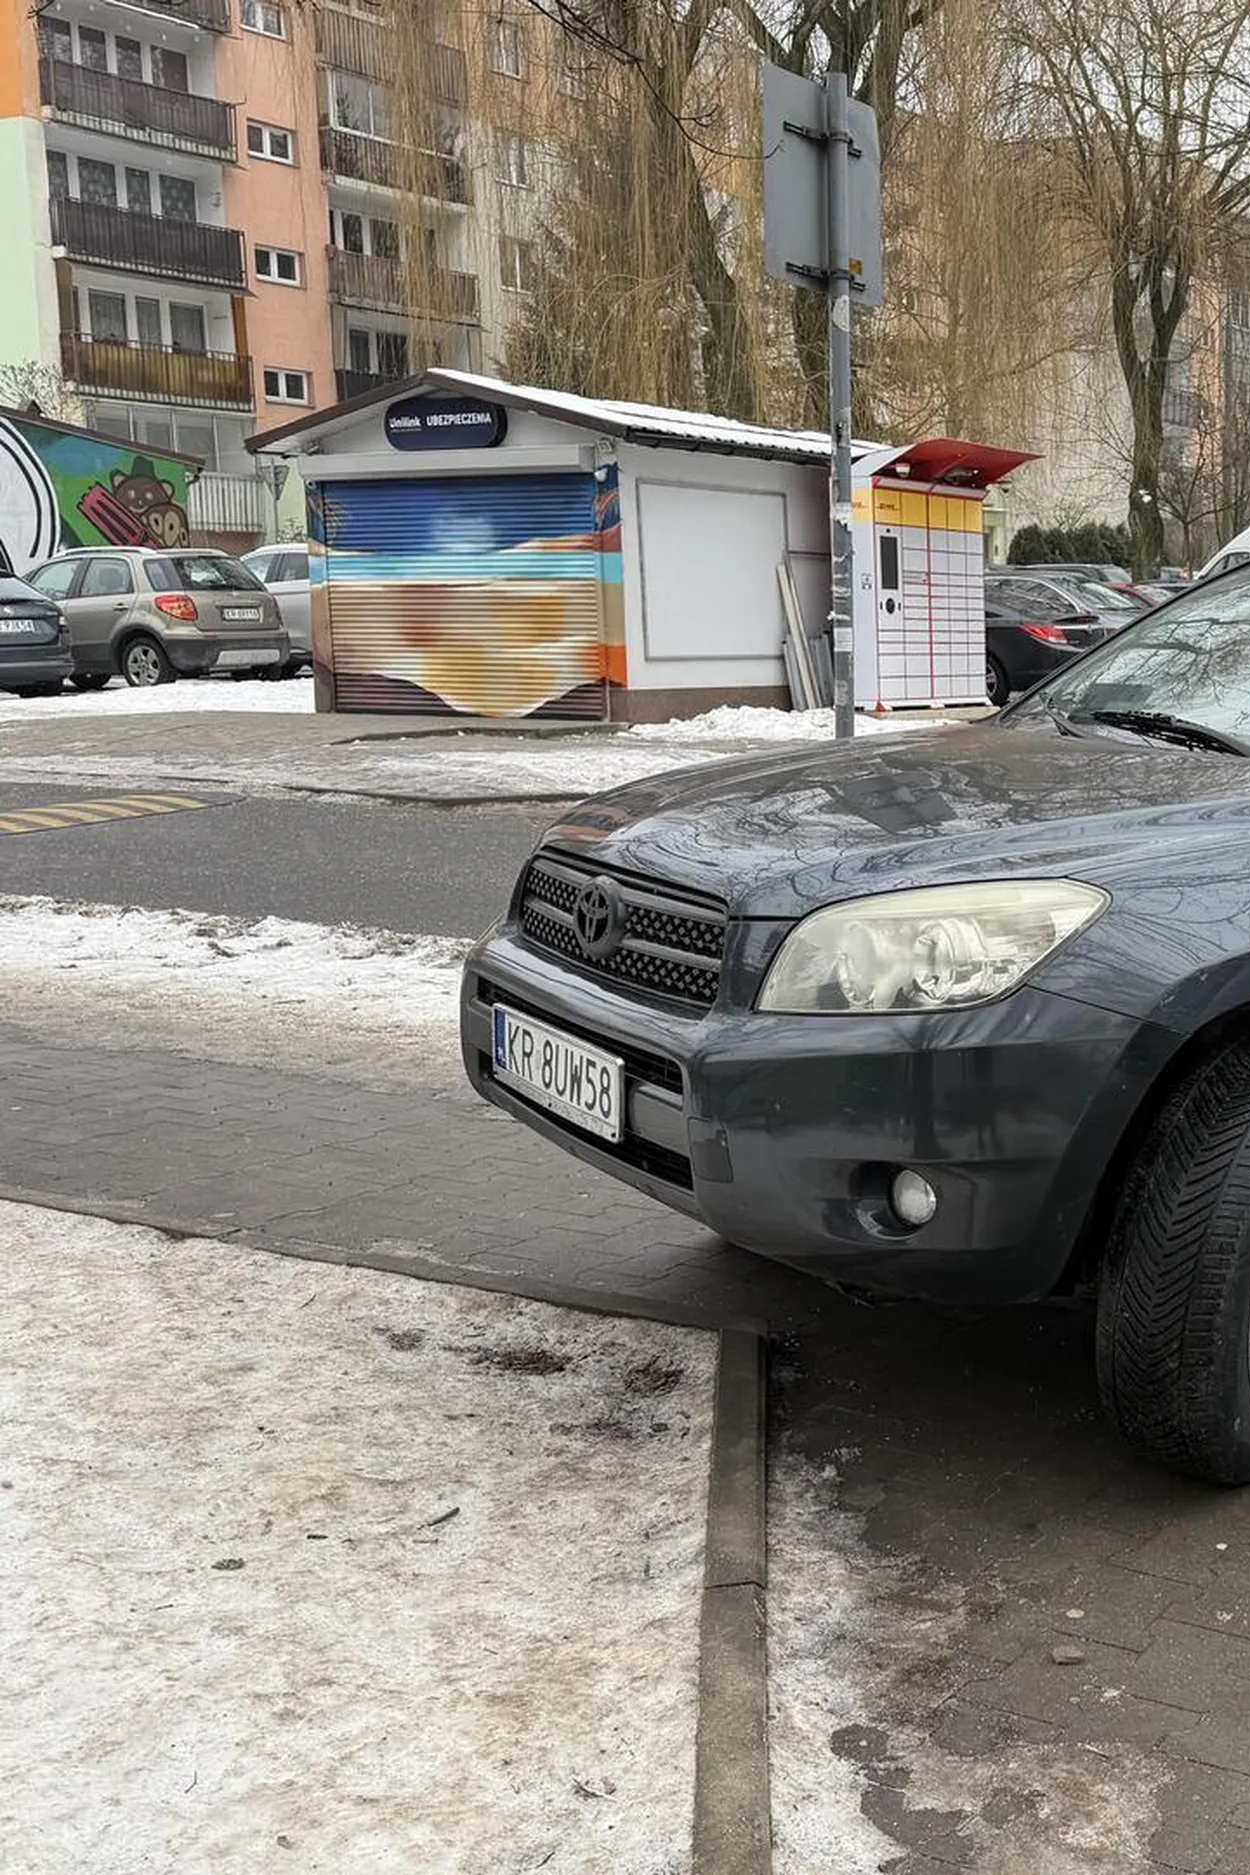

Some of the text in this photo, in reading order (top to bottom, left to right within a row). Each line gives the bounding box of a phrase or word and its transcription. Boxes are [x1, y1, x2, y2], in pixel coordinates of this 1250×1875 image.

[426, 412, 492, 426] UBEZPIECZENIA
[508, 1022, 612, 1119] KR 8UW58
